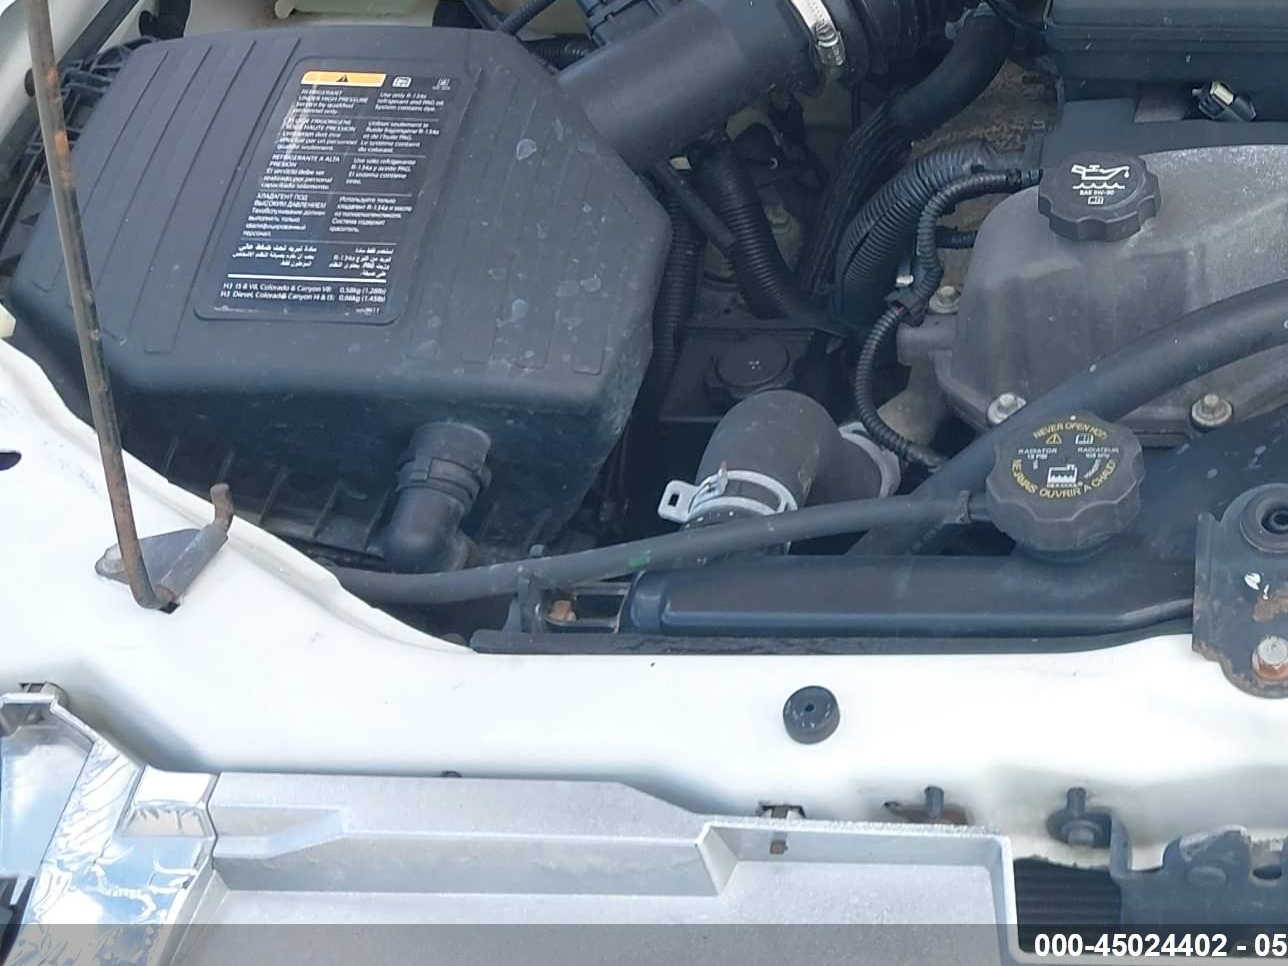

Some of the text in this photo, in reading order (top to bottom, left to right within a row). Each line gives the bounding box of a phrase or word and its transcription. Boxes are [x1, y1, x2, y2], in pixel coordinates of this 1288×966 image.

[260, 283, 290, 292] Colorado
[296, 285, 322, 293] Canyon
[287, 293, 313, 302] Canyon
[1032, 422, 1090, 438] NEVER OPEN
[1040, 488, 1082, 499] OUVRIR
[1092, 459, 1117, 488] CHAUD
